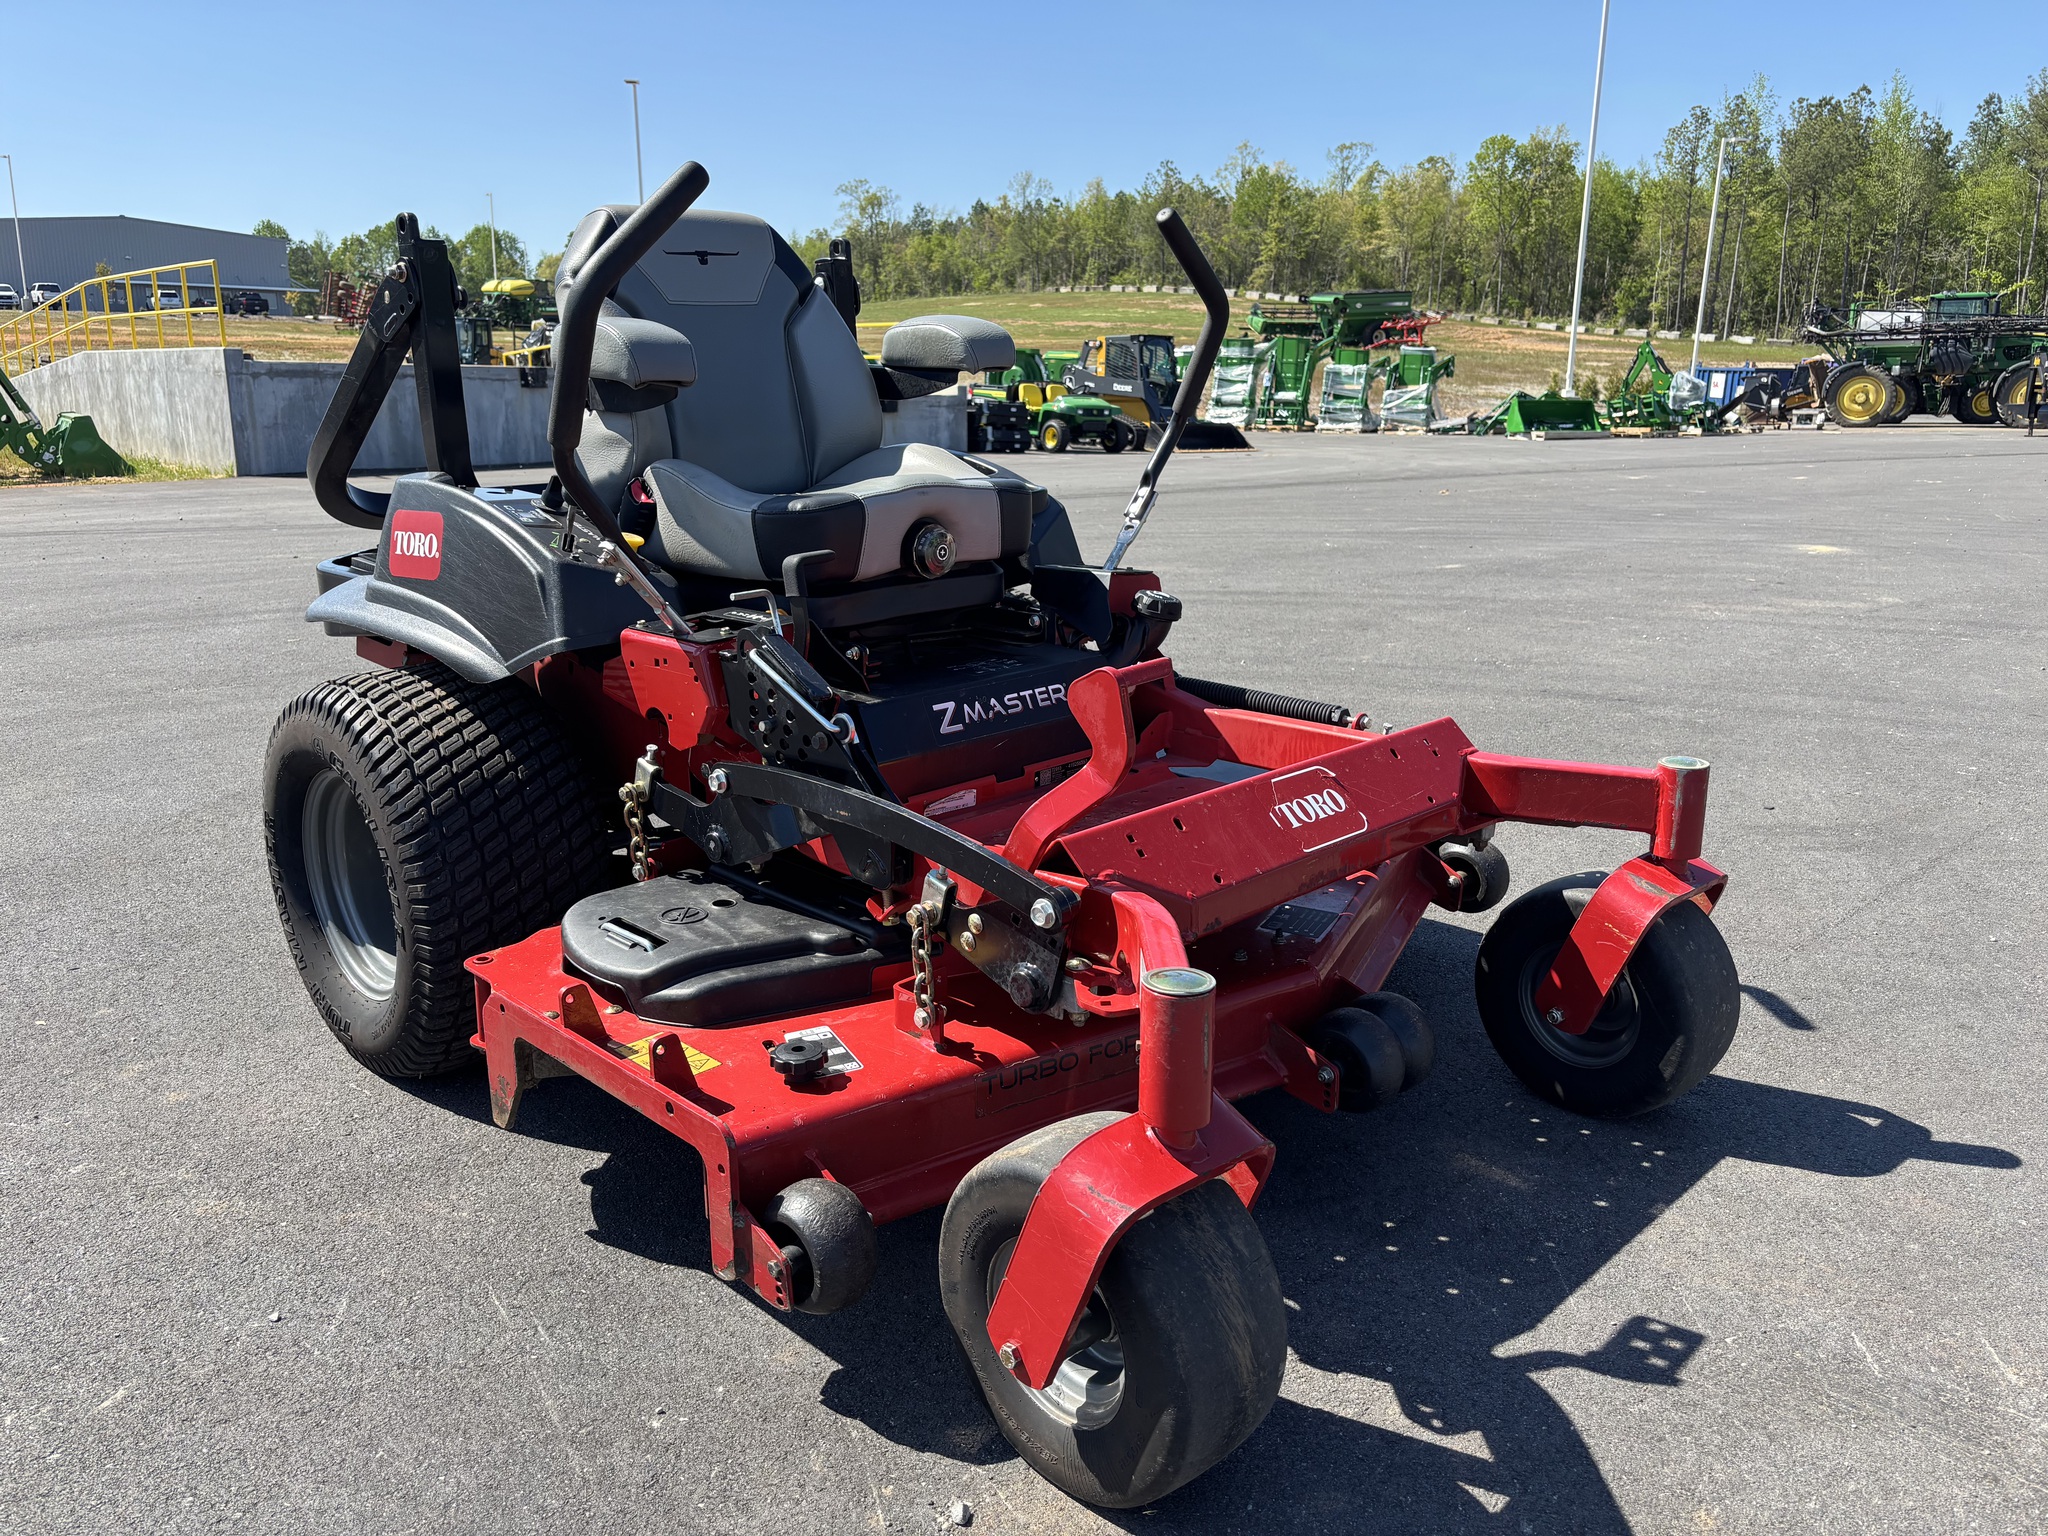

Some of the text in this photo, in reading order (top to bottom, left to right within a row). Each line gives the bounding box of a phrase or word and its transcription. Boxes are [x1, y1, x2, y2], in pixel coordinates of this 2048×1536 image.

[393, 530, 439, 558] TORO
[1273, 788, 1346, 828] TORO
[981, 1052, 1079, 1095] TURBO
